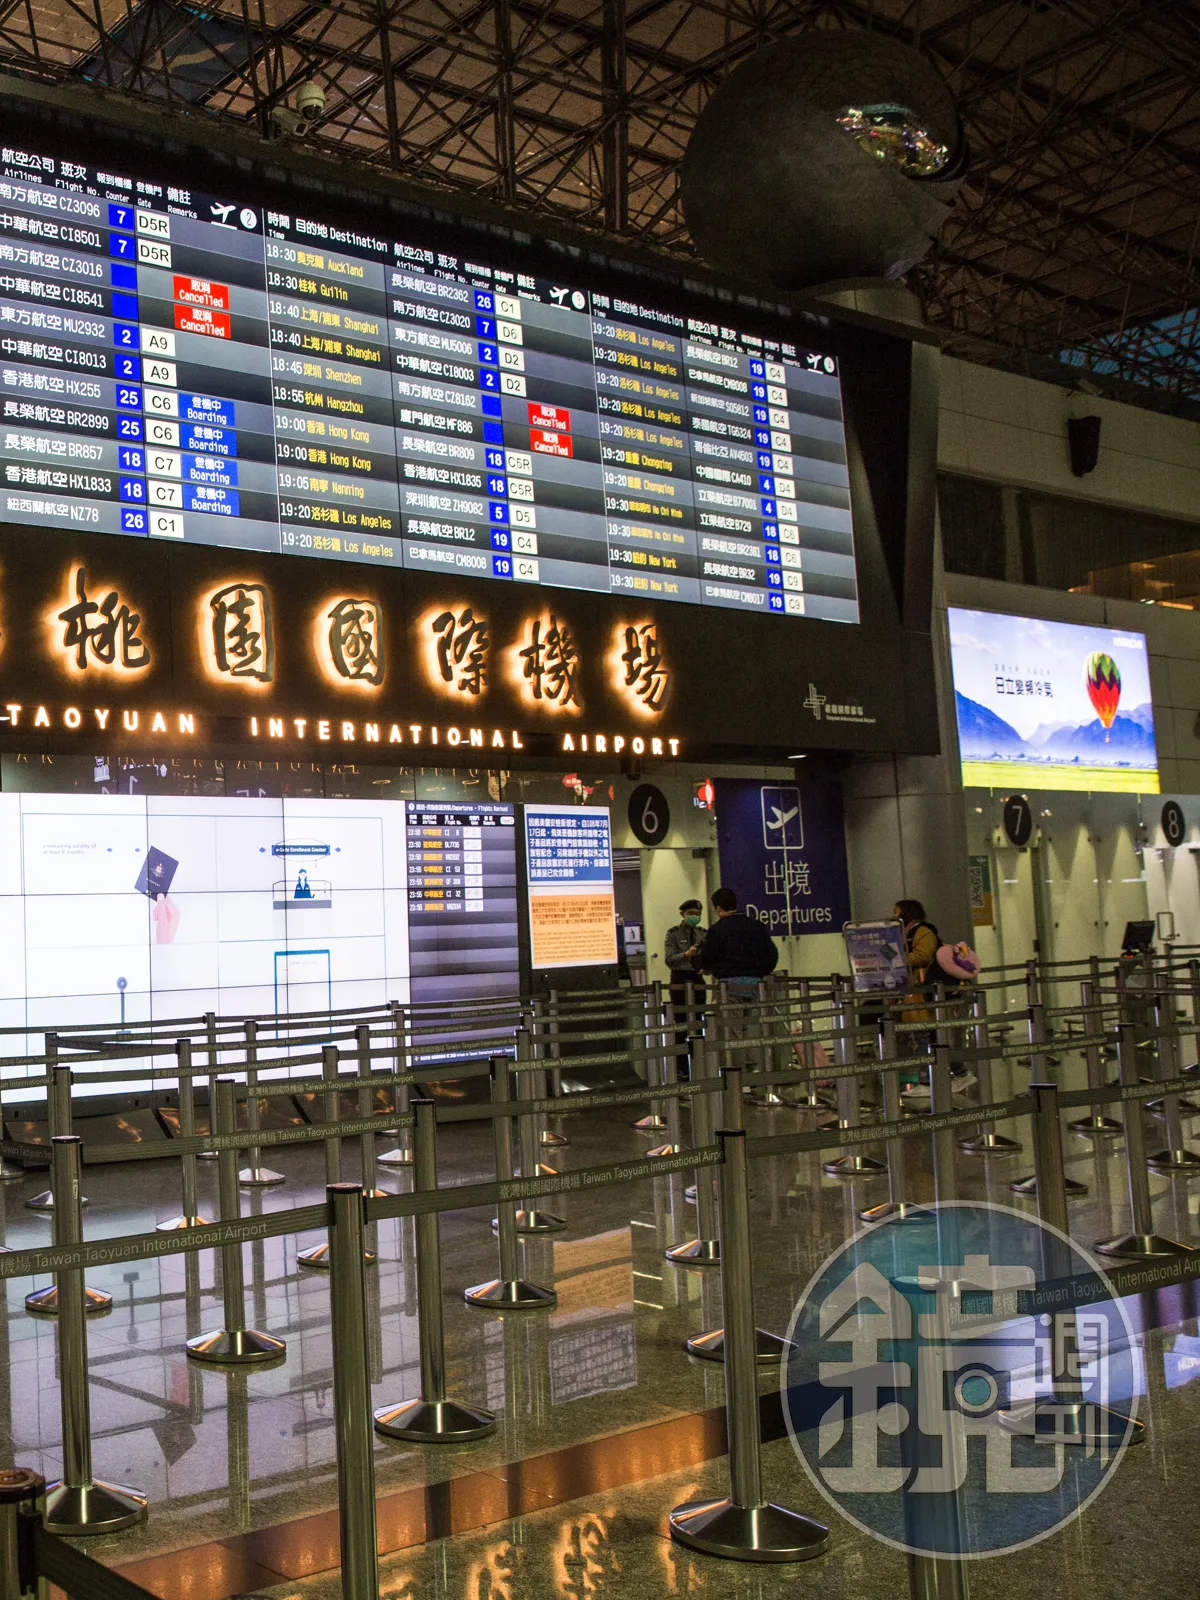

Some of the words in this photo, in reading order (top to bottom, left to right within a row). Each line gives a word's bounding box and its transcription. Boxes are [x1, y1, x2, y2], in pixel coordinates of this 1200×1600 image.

[61, 257, 103, 278] CZ3016
[179, 289, 223, 308] Cancelled
[190, 280, 210, 294] 取消
[592, 322, 615, 337] 19:20
[638, 335, 649, 345] Los
[651, 338, 674, 352] Angeles
[751, 363, 762, 374] 19
[769, 367, 780, 378] C4
[4, 433, 66, 456] 長榮航空
[68, 442, 103, 461] BR857
[123, 452, 140, 466] 18
[154, 456, 174, 471] C7
[276, 416, 305, 431] 19:00
[306, 421, 325, 435] 香港
[328, 425, 347, 438] Hong
[350, 428, 369, 442] Kong
[401, 436, 448, 455] 長榮航空
[448, 445, 474, 459] BR809
[488, 453, 502, 465] 18
[508, 457, 530, 470] C5R
[190, 468, 229, 484] Boarding
[195, 456, 224, 471] 登機中
[9, 705, 195, 735] TAOYUAN
[252, 717, 522, 749] INTERNATIONAL
[564, 735, 680, 756] AIRPORT
[642, 797, 658, 833] 6
[1012, 805, 1022, 835] 7
[1168, 809, 1179, 837] 8
[765, 861, 812, 896] 出境
[746, 903, 831, 931] Departures
[582, 1172, 612, 1184] Taiwan
[614, 1166, 648, 1180] Taoyuan
[651, 1155, 700, 1172] International
[702, 1151, 723, 1164] Airpo
[34, 1252, 80, 1267] Taiwan
[84, 1243, 138, 1261] Taoyuan
[143, 1231, 221, 1251] International
[225, 1222, 267, 1240] Airport
[1031, 1290, 1068, 1306] Taiwan
[1070, 1280, 1115, 1299] Taoyuan
[1118, 1262, 1181, 1287] International
